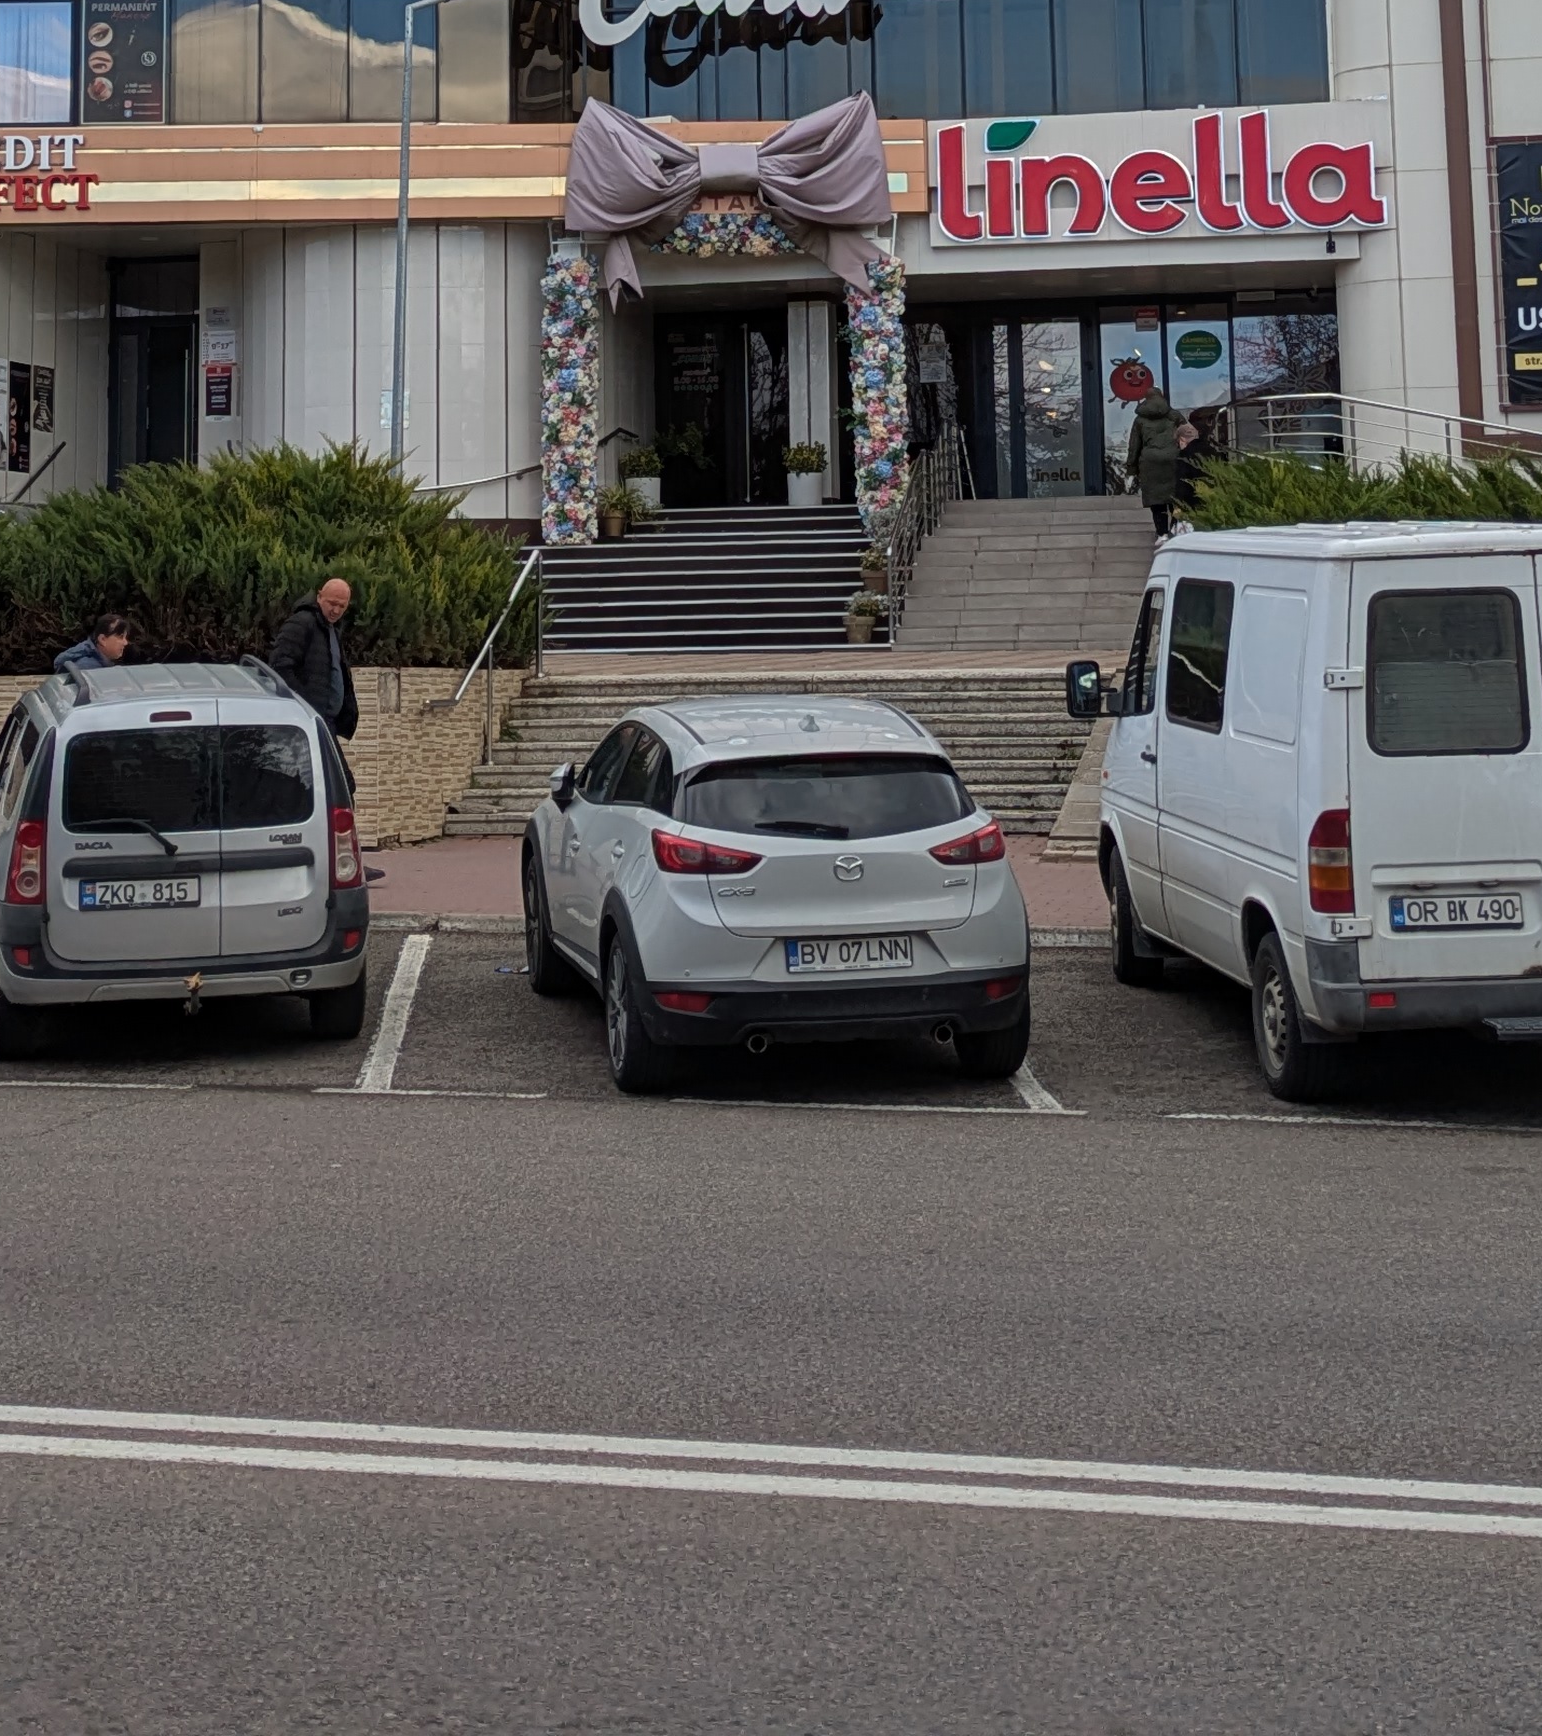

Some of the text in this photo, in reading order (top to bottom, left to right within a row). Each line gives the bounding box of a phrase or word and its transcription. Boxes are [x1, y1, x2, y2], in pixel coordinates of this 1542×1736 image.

[91, 2, 157, 12] PERMANENT
[936, 108, 1389, 242] linella
[75, 841, 113, 850] DACIA
[97, 882, 188, 905] ZKQ 815
[1406, 899, 1515, 923] OR BK 490
[800, 943, 829, 964] BV
